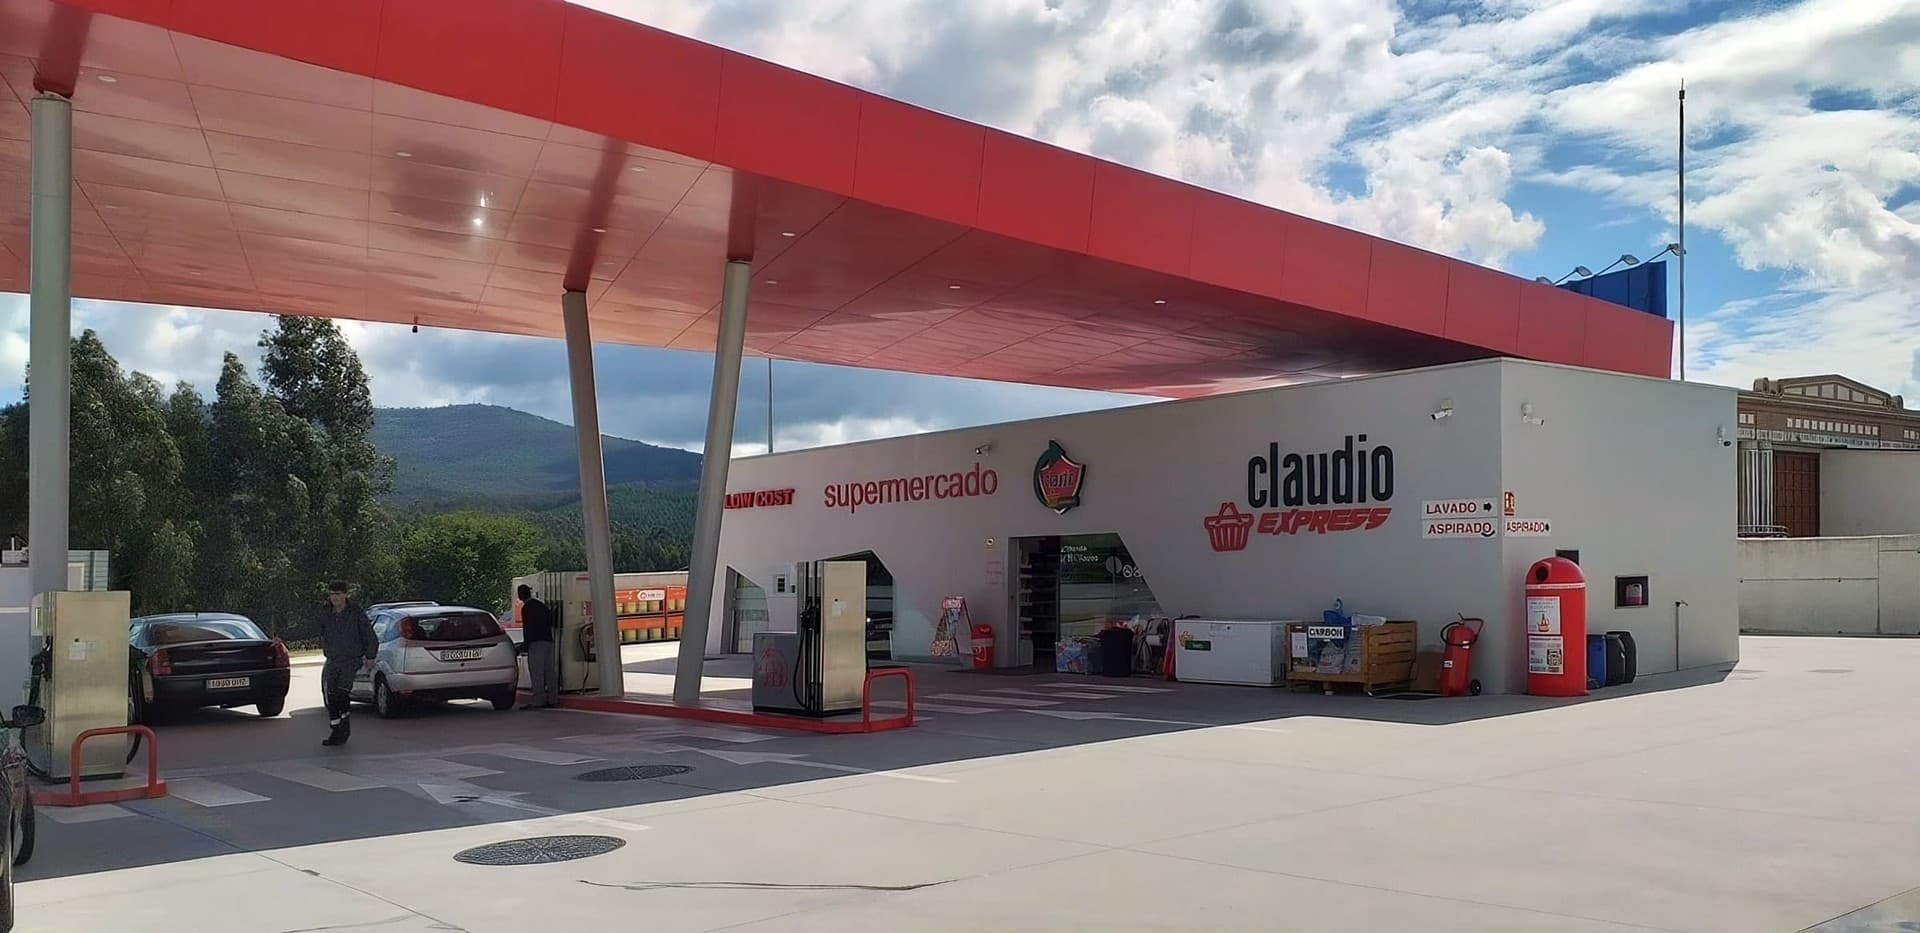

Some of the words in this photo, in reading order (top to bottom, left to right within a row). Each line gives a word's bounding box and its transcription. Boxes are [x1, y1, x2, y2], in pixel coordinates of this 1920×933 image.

[1248, 434, 1394, 508] claudio
[824, 463, 998, 514] supermercado
[724, 492, 755, 509] LOW
[756, 489, 796, 507] COST
[1426, 502, 1477, 515] LAVADO
[1257, 508, 1392, 536] EXPRESS
[1428, 522, 1492, 535] ASPIRADO
[1506, 521, 1545, 533] ASPIRADO
